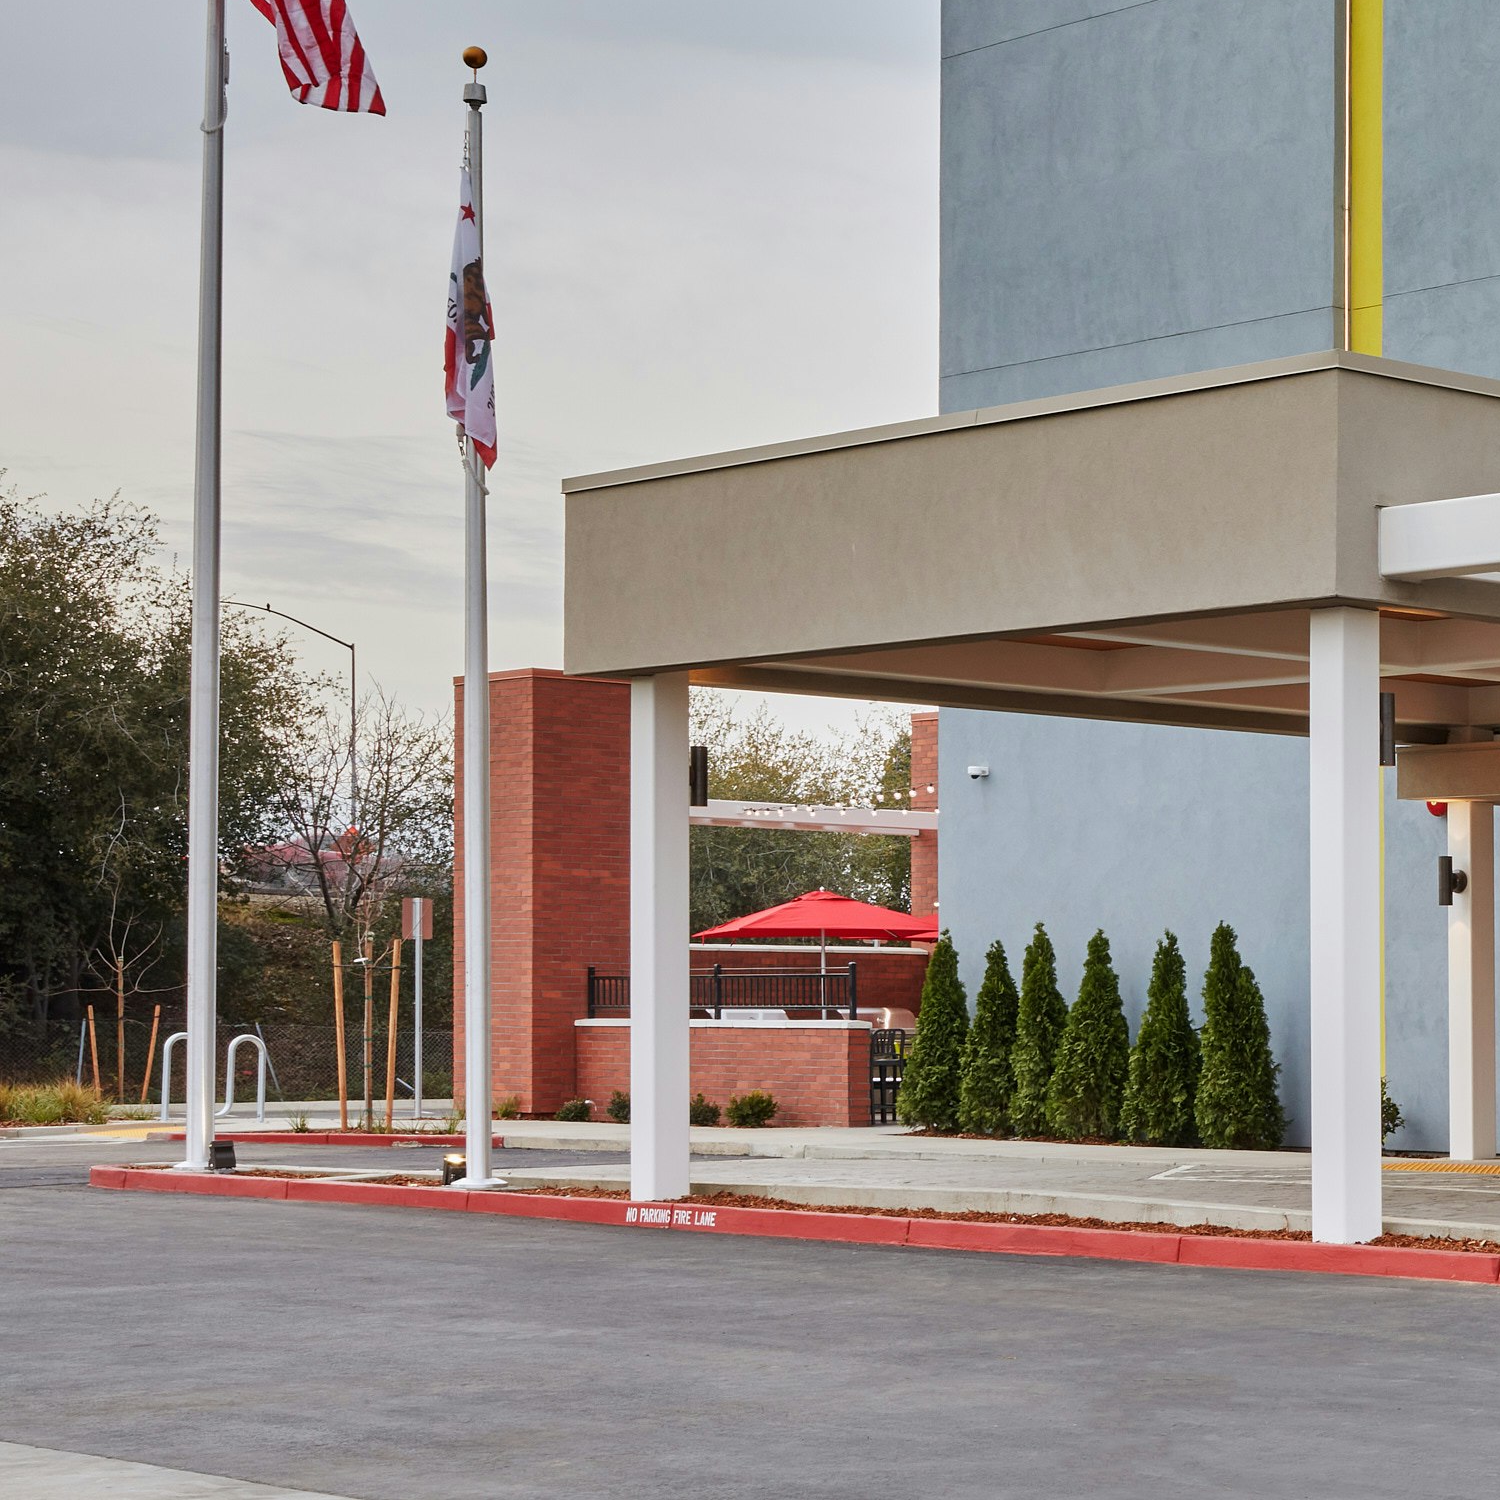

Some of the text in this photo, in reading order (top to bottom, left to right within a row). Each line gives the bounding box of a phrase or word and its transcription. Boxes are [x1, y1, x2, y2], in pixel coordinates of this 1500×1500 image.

[626, 1207, 717, 1227] NO PARKING FIRE LANE
